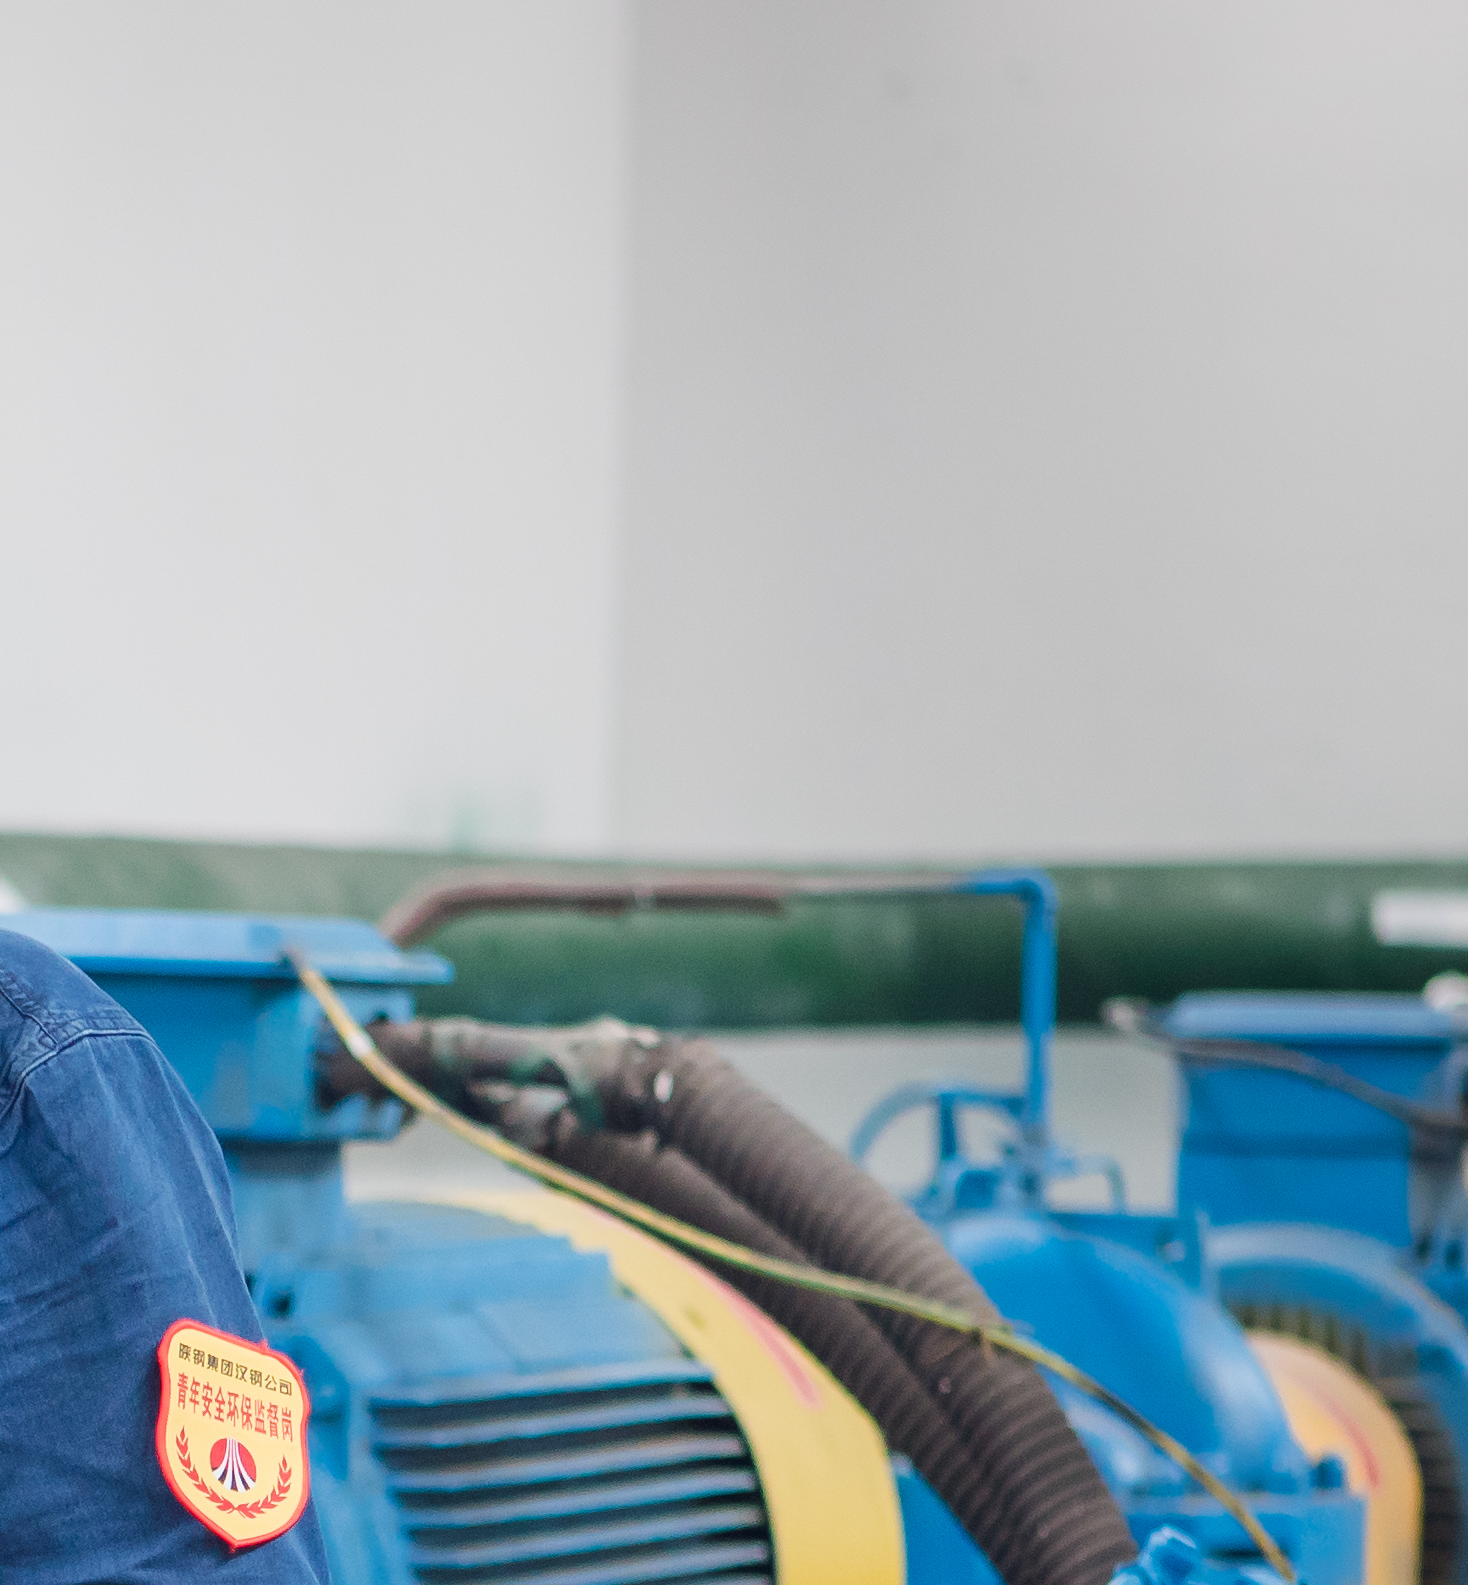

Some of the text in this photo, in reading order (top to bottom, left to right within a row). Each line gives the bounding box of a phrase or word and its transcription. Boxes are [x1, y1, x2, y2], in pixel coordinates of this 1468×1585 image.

[179, 1342, 293, 1397] 陕钢集团汉钢公司
[177, 1371, 294, 1442] 青年安全环保监督岗
